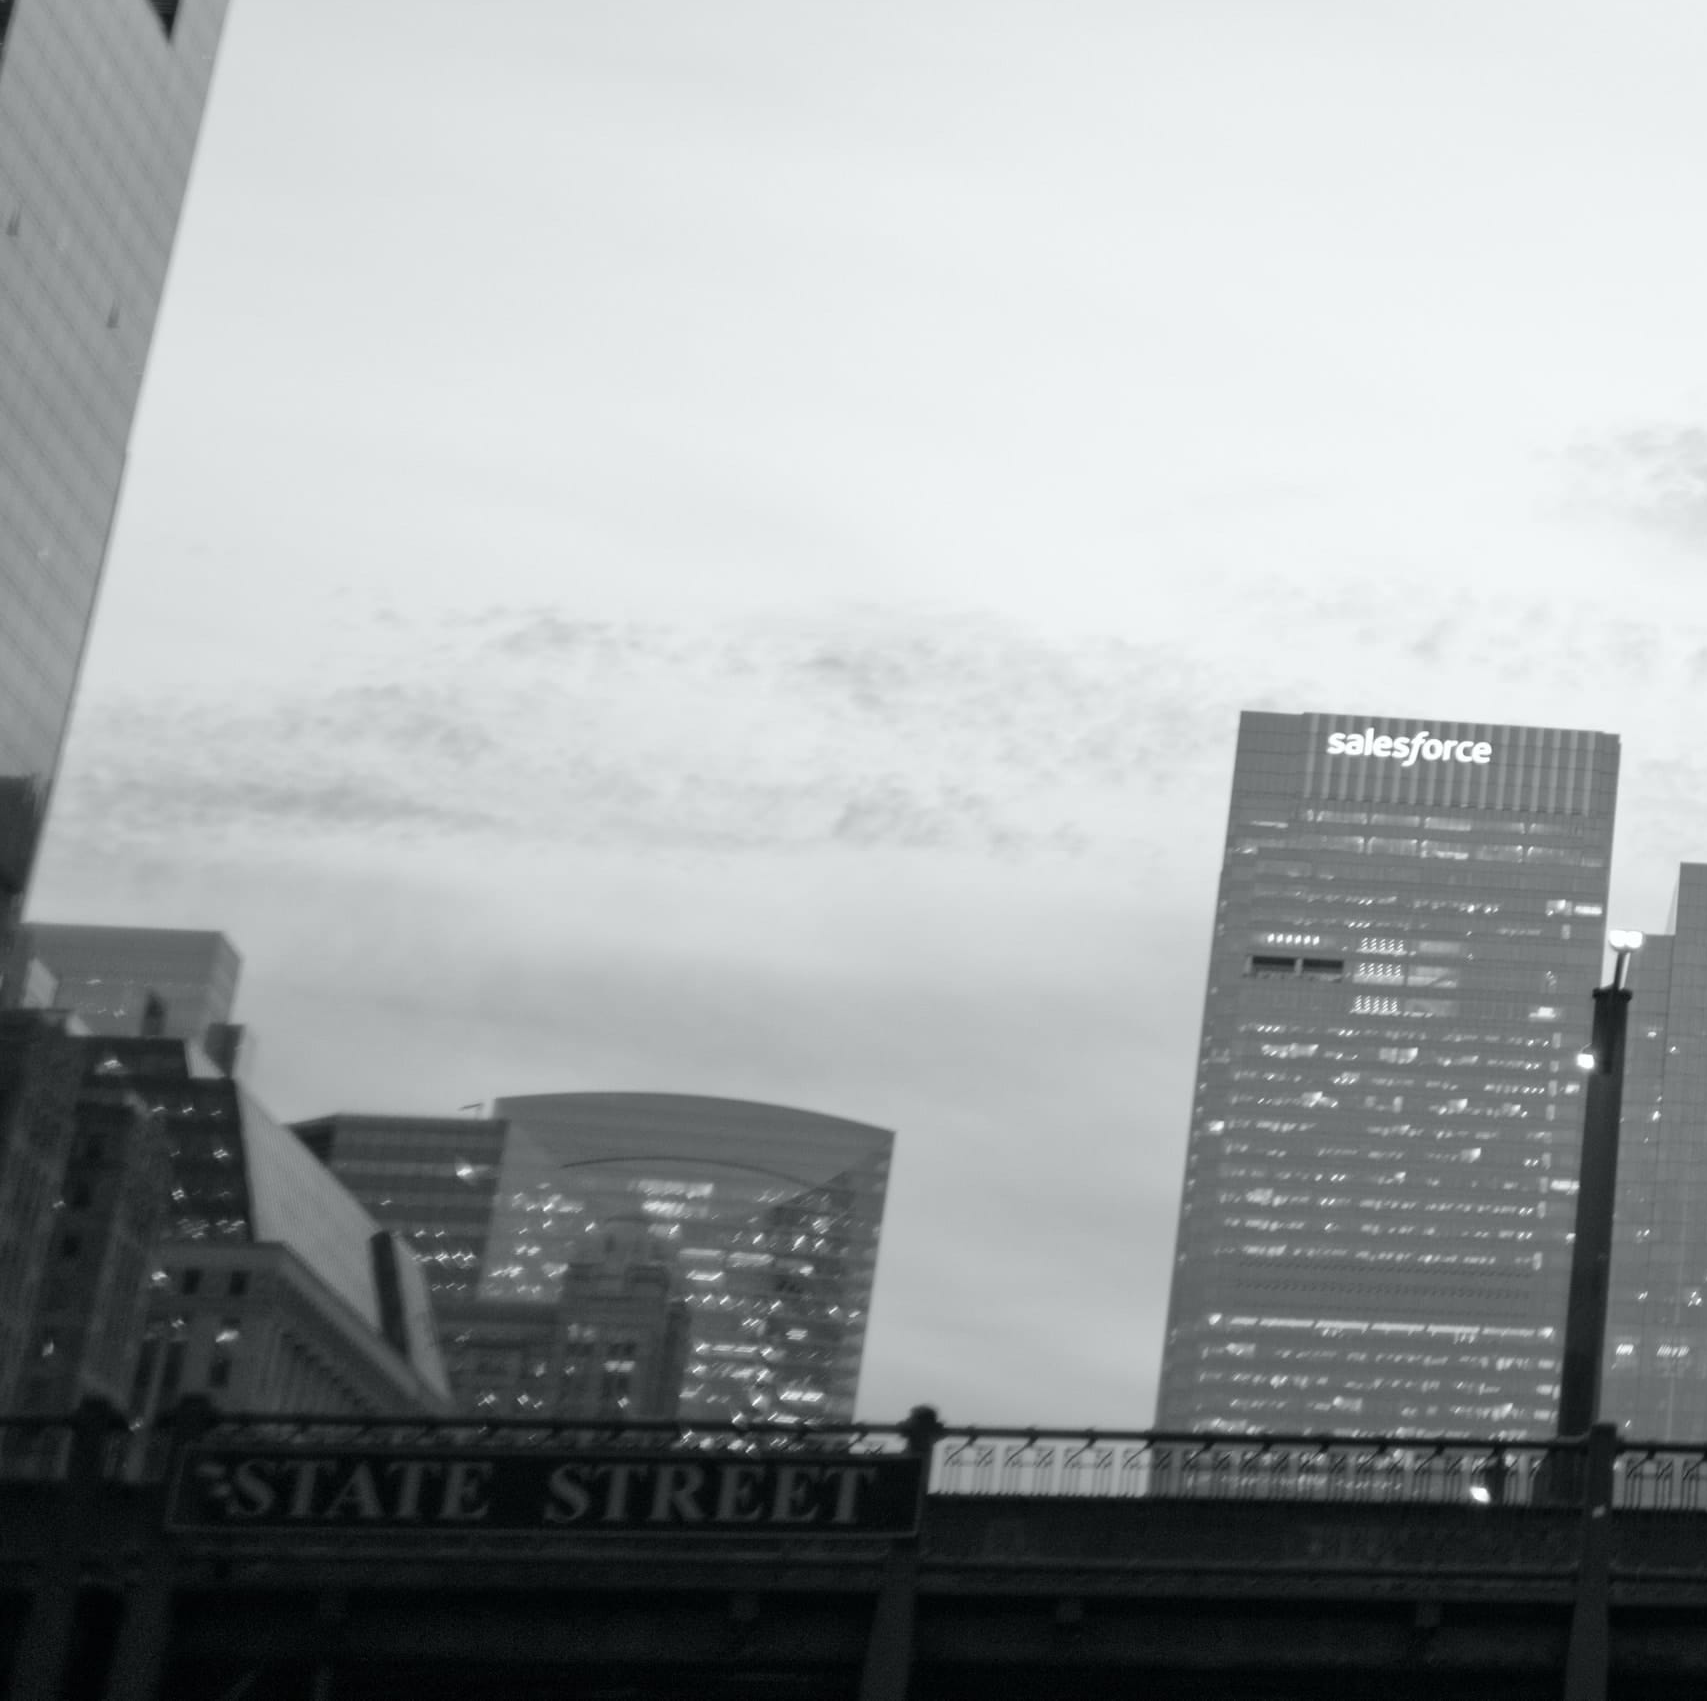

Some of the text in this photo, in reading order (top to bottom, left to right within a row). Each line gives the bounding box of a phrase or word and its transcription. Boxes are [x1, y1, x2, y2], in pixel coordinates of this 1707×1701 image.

[1327, 727, 1492, 767] salesforce
[225, 1458, 876, 1524] STATE STREET
